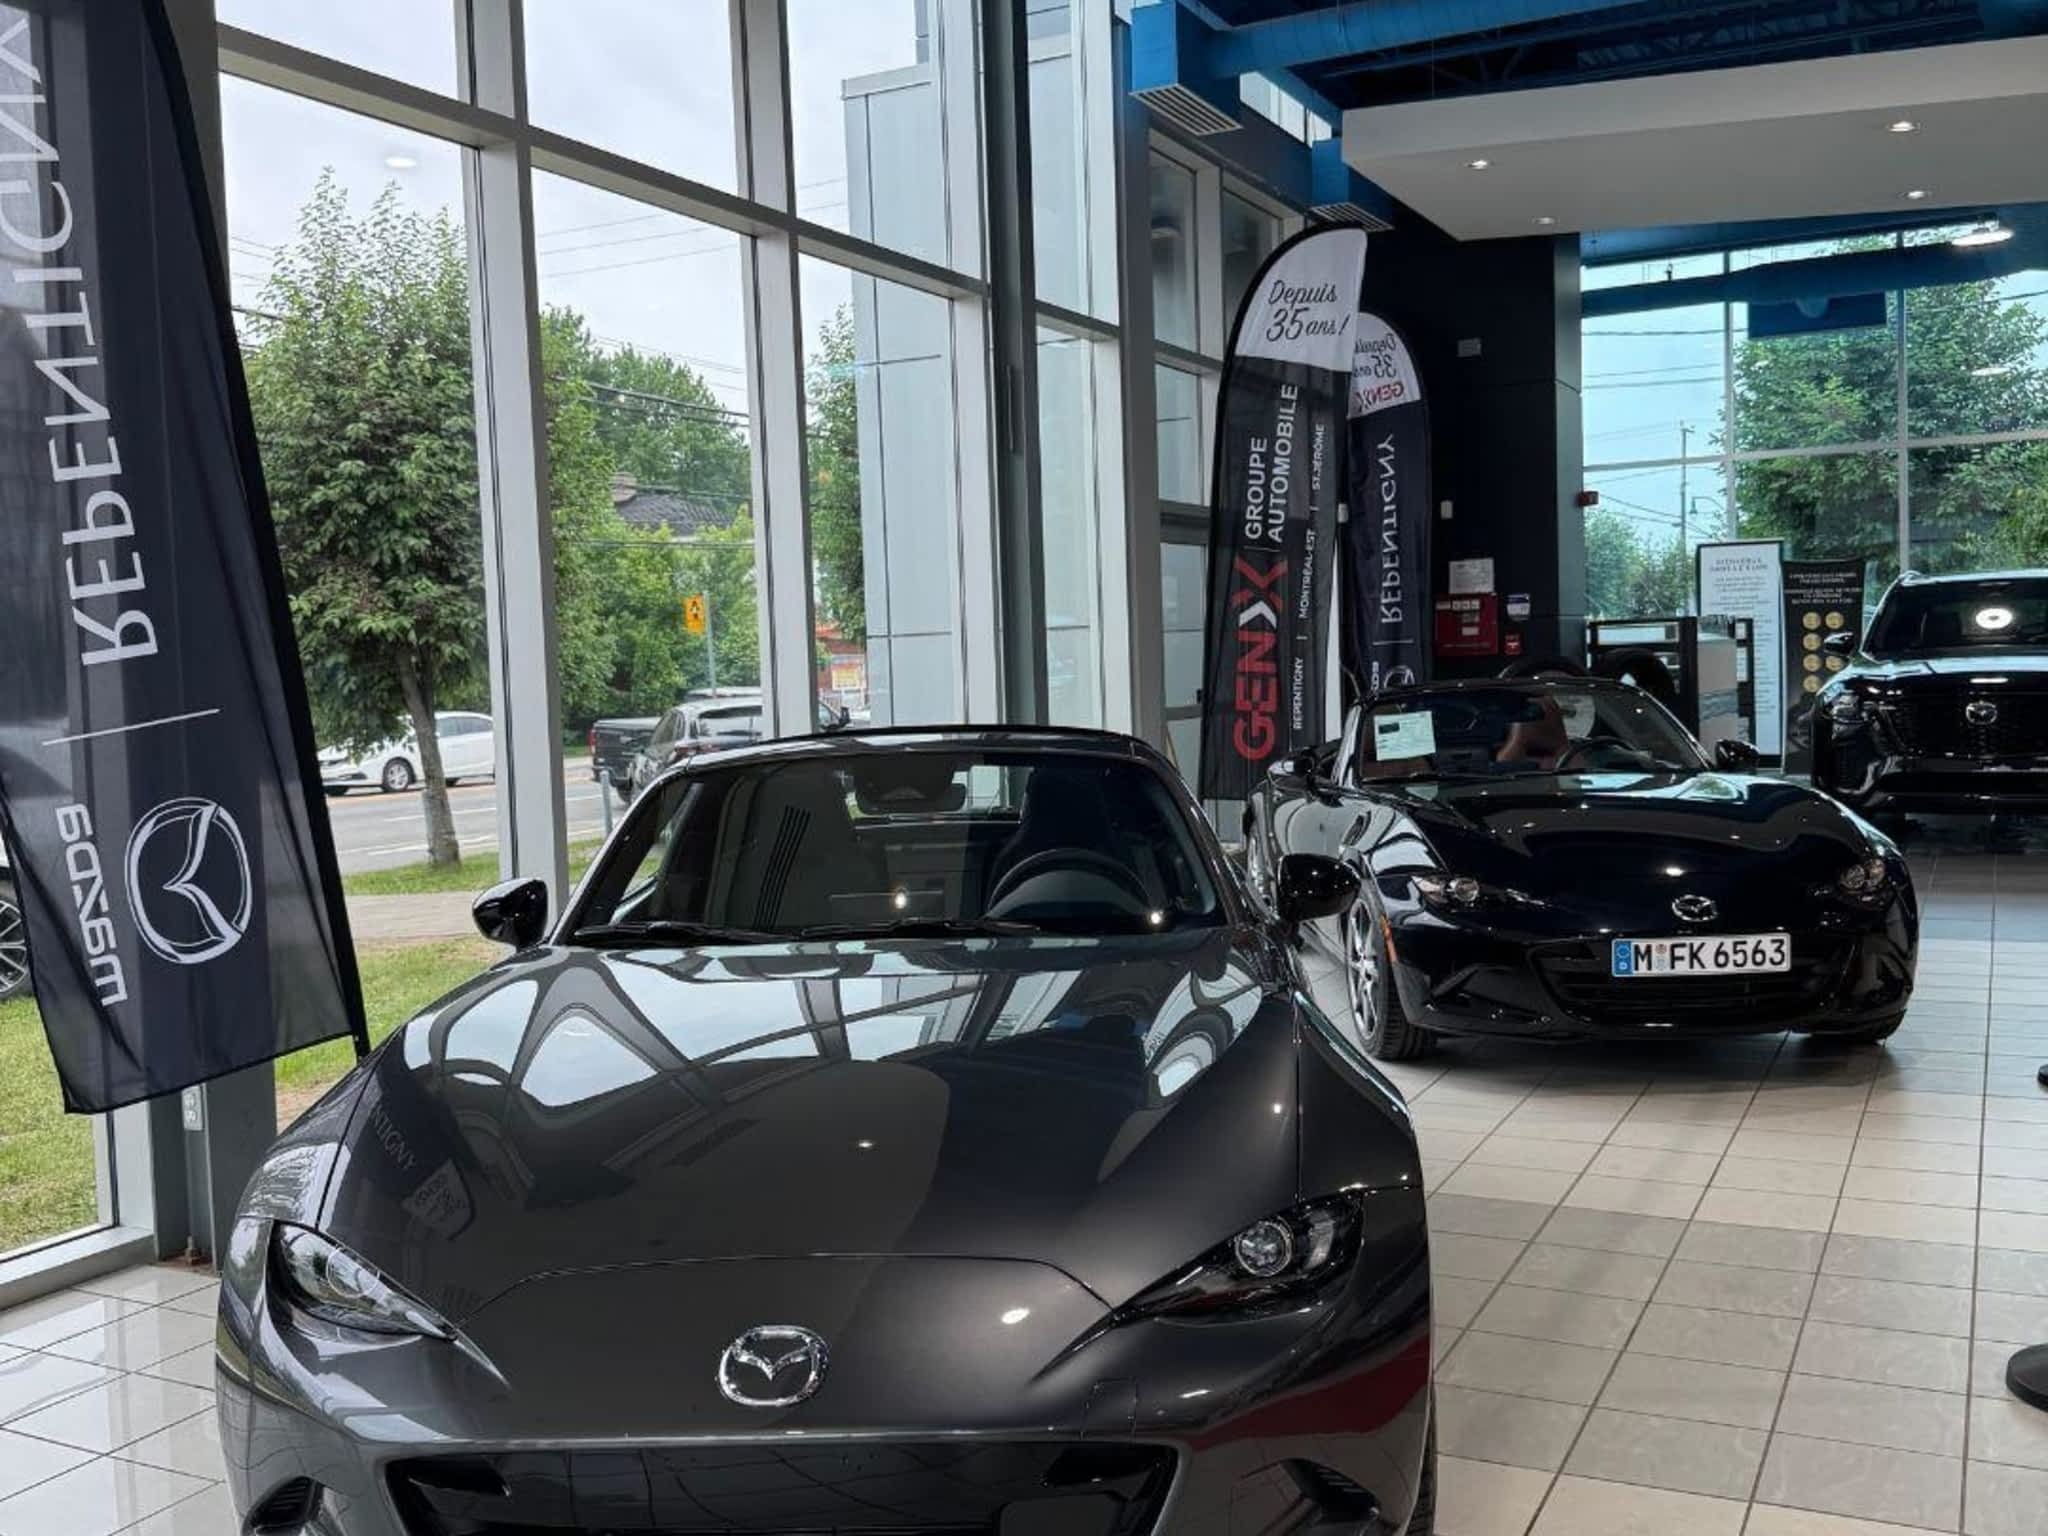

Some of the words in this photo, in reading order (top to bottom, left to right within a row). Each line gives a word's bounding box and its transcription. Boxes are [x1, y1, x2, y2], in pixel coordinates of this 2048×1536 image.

[1268, 279, 1337, 311] Depuis
[1266, 306, 1310, 343] 35
[1306, 312, 1350, 337] ans!
[1244, 437, 1268, 540] GROUPE
[1268, 384, 1299, 543] AUTOMOBILE
[1292, 655, 1305, 731] REPENTIGNY
[1634, 943, 1653, 971] M
[1669, 941, 1706, 970] FK
[1713, 938, 1786, 969] 6563
